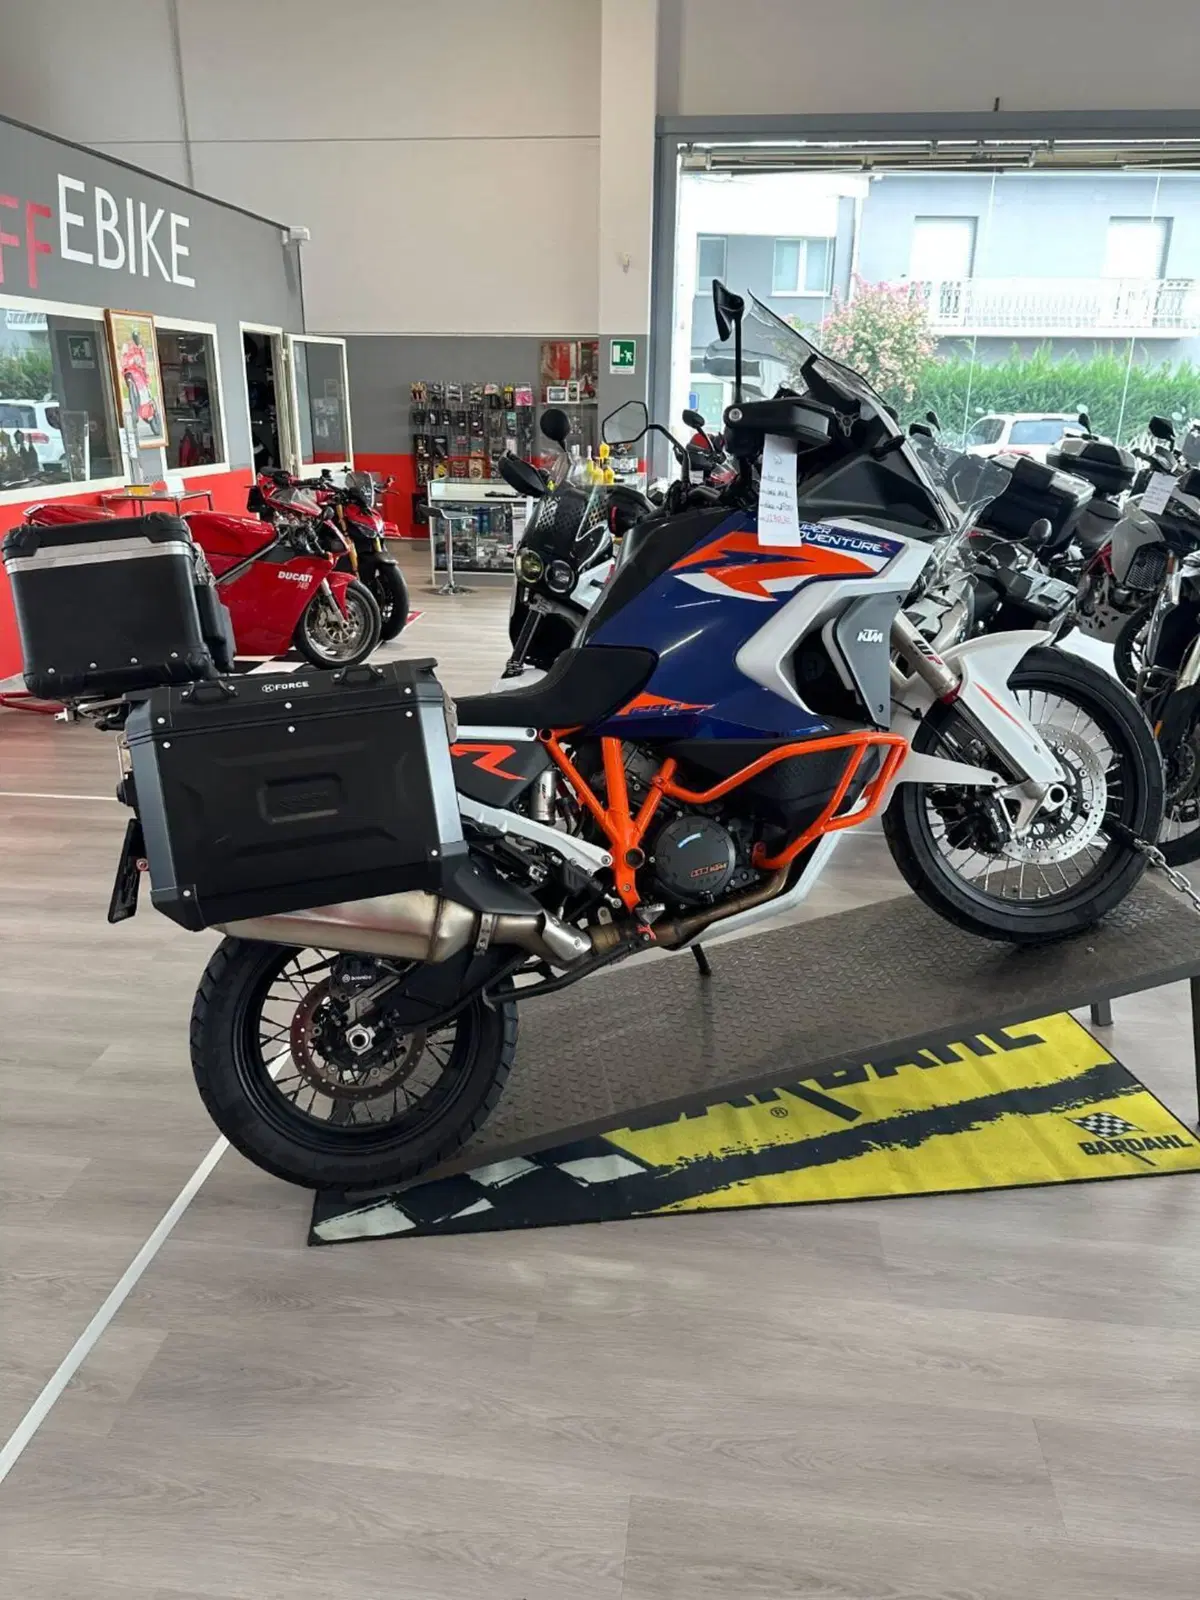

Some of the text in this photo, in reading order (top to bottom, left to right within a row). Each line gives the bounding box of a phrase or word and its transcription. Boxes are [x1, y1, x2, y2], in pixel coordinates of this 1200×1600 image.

[799, 523, 832, 535] UPER
[800, 531, 883, 553] DVENTURE
[278, 570, 313, 583] DUCATI
[857, 628, 883, 643] KTM
[1078, 1134, 1194, 1156] BARDAHL
